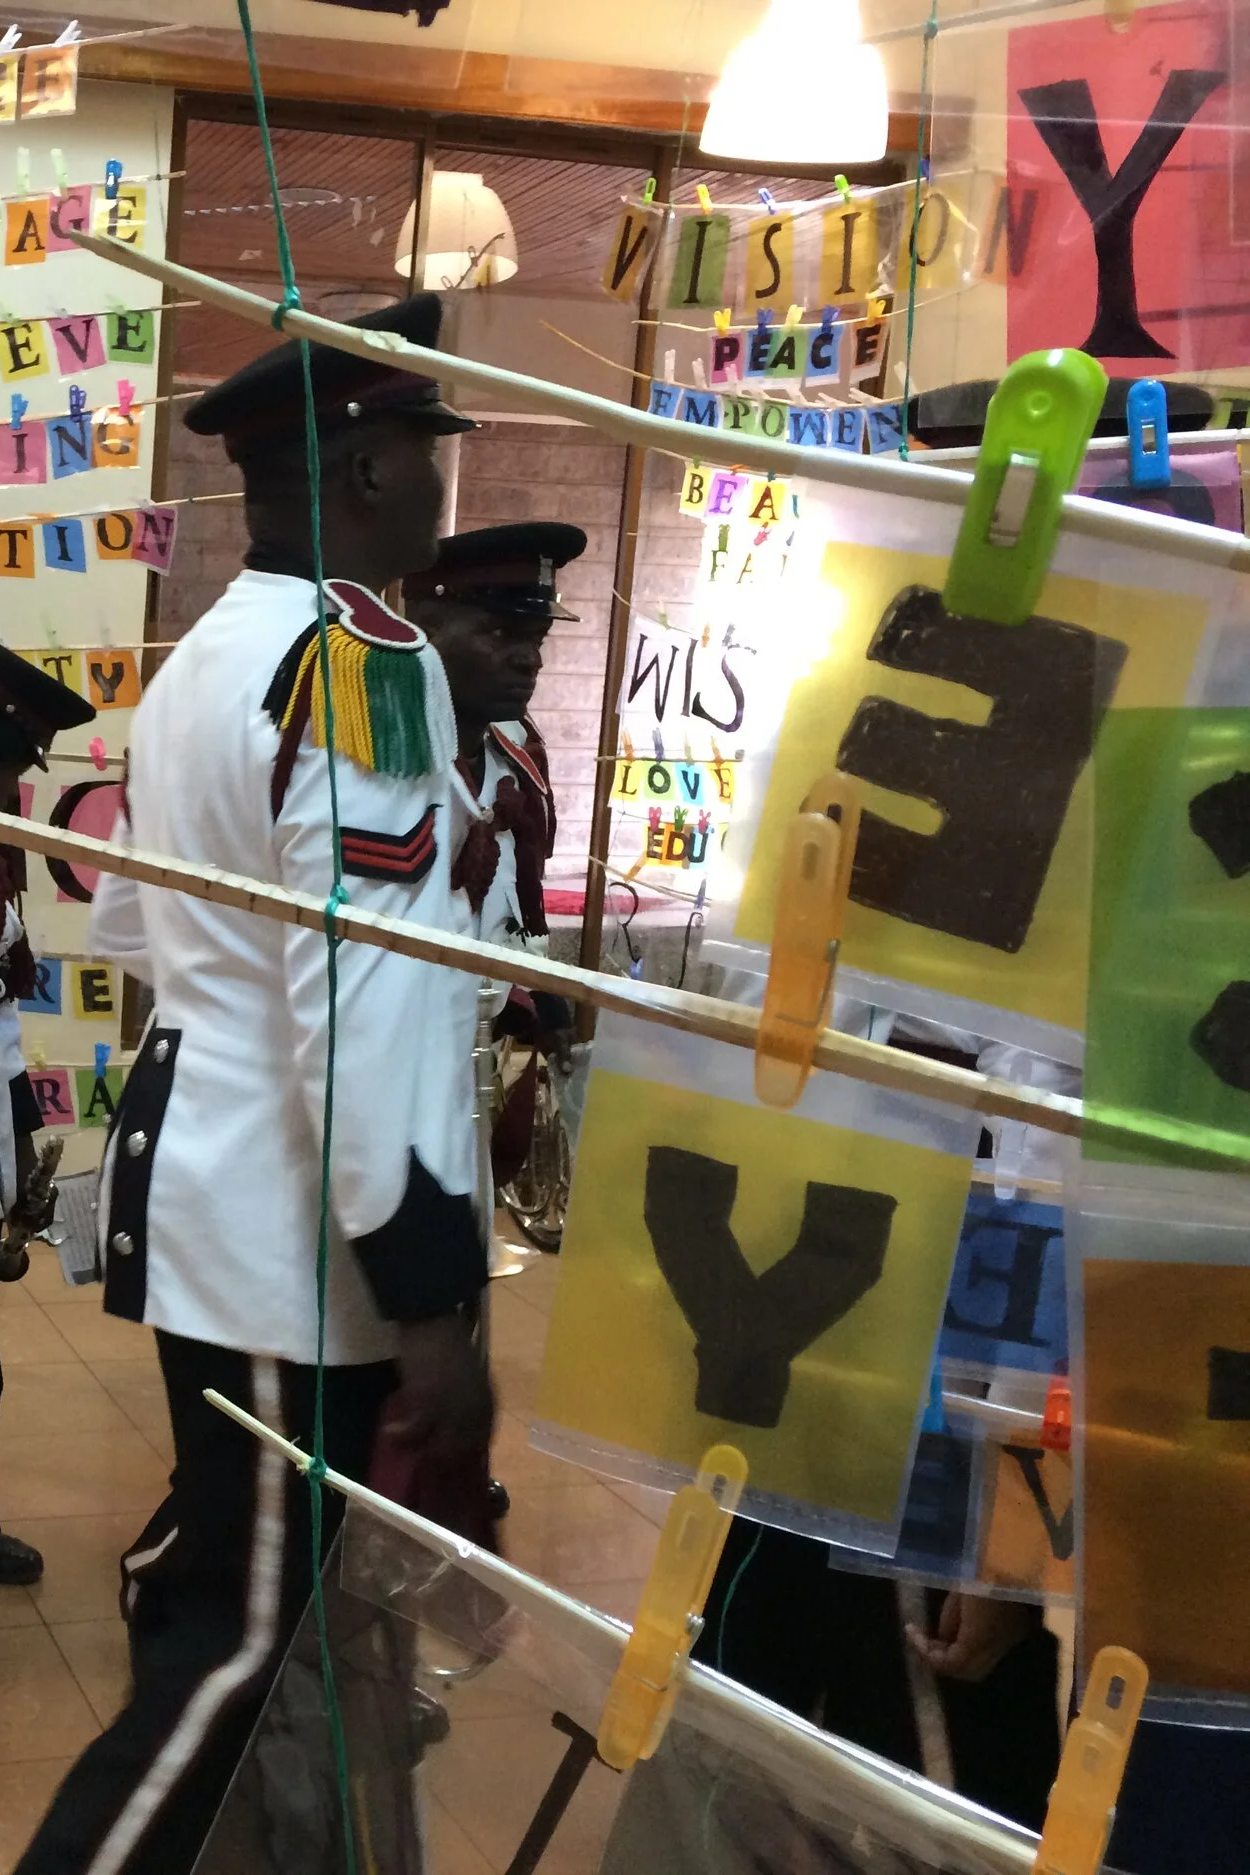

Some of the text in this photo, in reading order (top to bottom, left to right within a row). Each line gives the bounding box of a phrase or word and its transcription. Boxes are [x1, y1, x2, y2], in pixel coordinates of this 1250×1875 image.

[611, 187, 1039, 303] VISION
[714, 322, 882, 371] PEACE
[618, 764, 731, 800] LOVE
[647, 826, 729, 863] EDU
